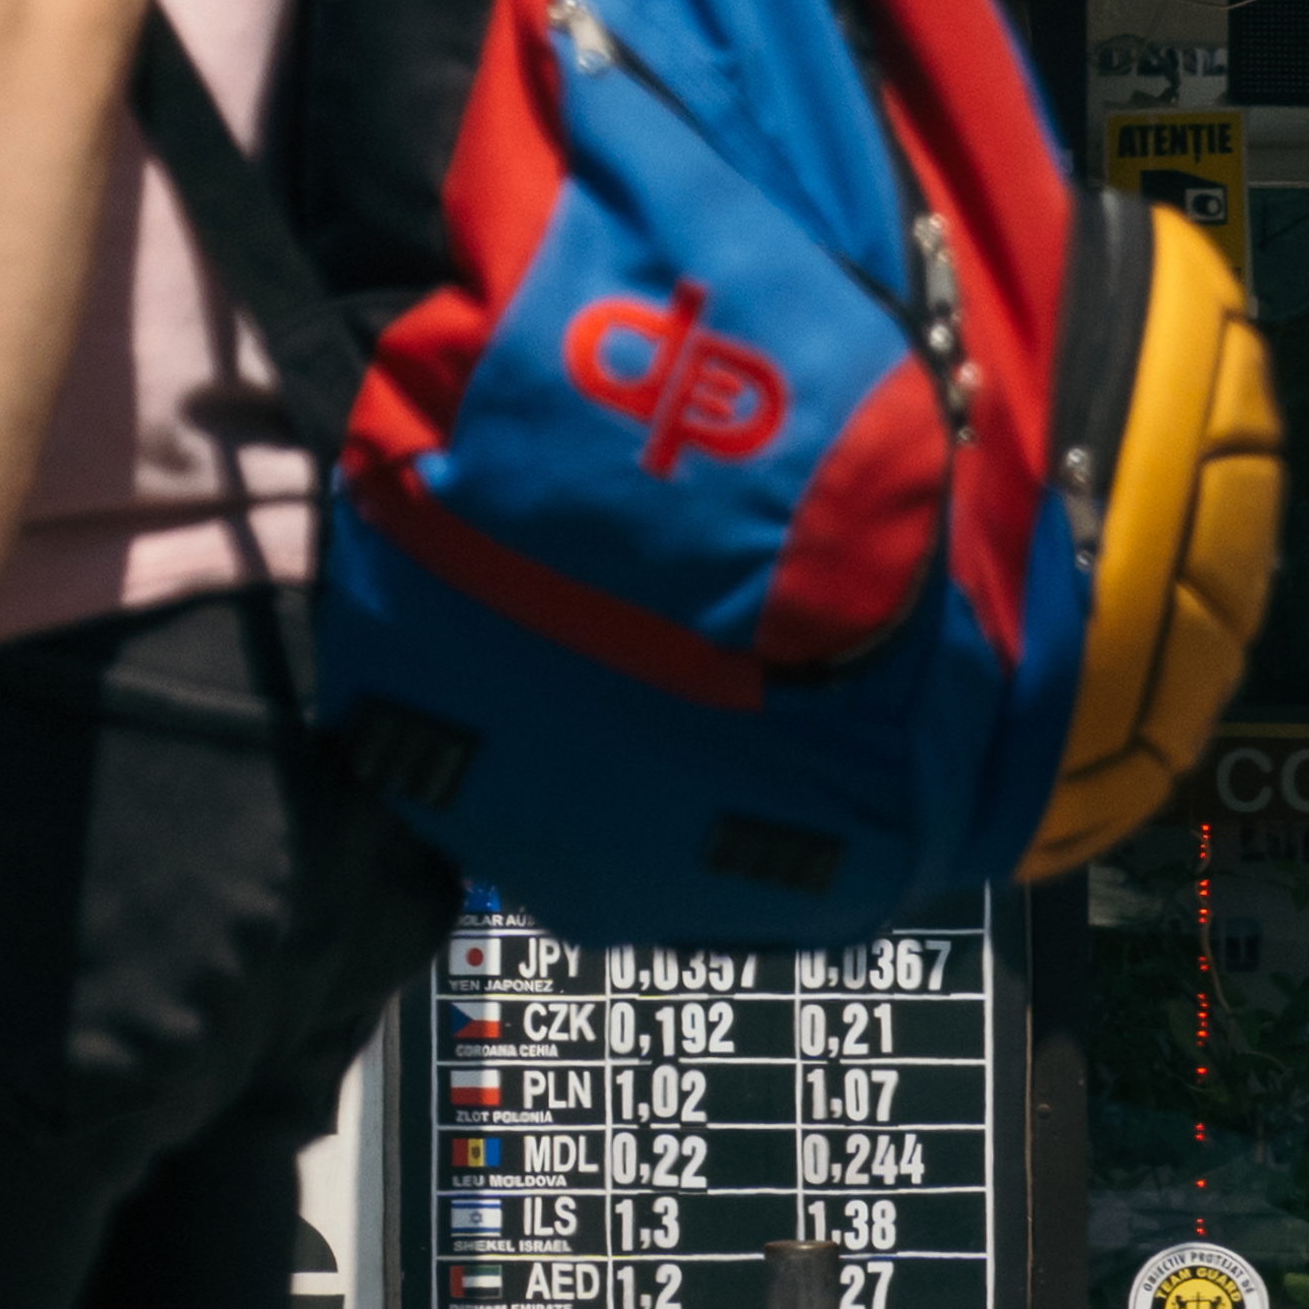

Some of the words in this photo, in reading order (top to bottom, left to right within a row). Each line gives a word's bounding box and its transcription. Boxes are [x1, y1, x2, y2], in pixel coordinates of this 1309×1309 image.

[519, 938, 580, 979] JPY
[610, 945, 757, 992] 0,0357
[800, 938, 952, 991] 0,0367
[484, 979, 554, 992] JAPONEZ
[523, 1002, 597, 1042] CZK
[610, 1002, 735, 1057] 0,192
[801, 1002, 893, 1058] 0,21
[519, 1043, 559, 1057] CEHIA
[523, 1070, 592, 1109] PLN
[616, 1064, 708, 1122] 1,02
[807, 1068, 899, 1121] 1,07
[455, 1110, 490, 1123] ZLOT
[492, 1110, 554, 1123] POLONIA
[524, 1135, 599, 1173] MDL
[612, 1131, 708, 1188] 0,22
[803, 1133, 925, 1185] 0,244
[452, 1175, 486, 1187] LEU
[489, 1175, 568, 1187] MOLDOVA
[523, 1196, 578, 1236] ILS
[615, 1196, 680, 1251] 1,3
[453, 1240, 516, 1252] SHEKEL
[518, 1240, 574, 1252] ISRAEL
[525, 1261, 600, 1300] AED
[1154, 1267, 1193, 1299] TEAM
[1196, 1267, 1243, 1302] GUARD
